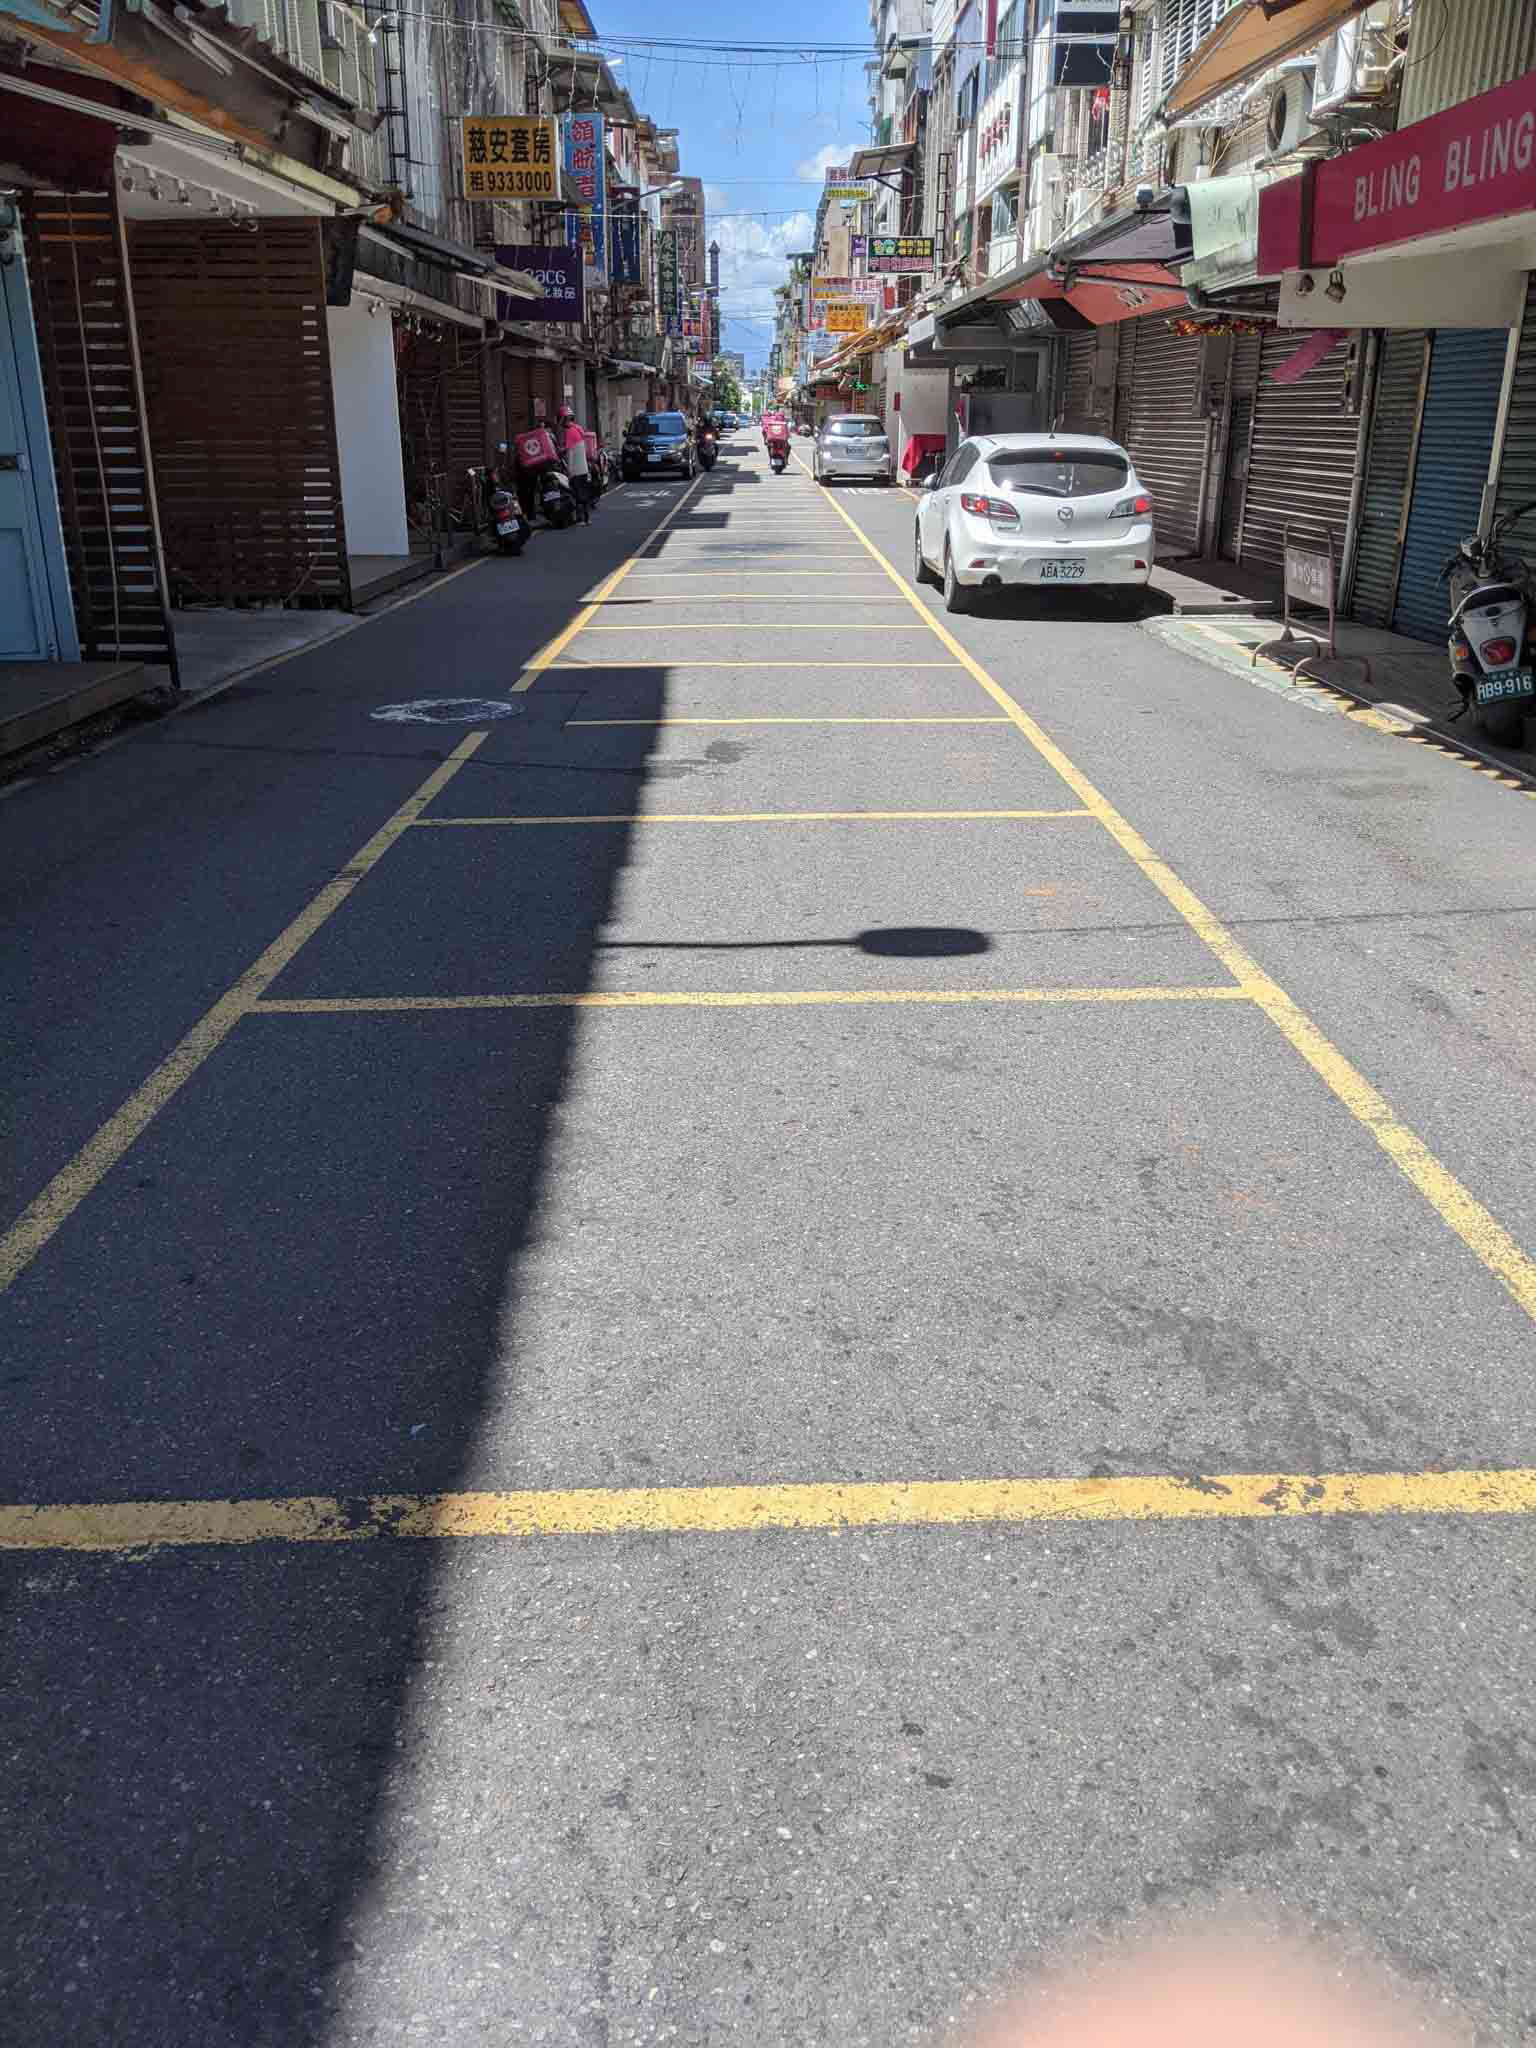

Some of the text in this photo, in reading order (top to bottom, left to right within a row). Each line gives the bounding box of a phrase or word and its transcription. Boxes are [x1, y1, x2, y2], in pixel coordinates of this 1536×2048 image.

[467, 126, 551, 163] 慈安套房
[1354, 112, 1535, 222] BLING BLING
